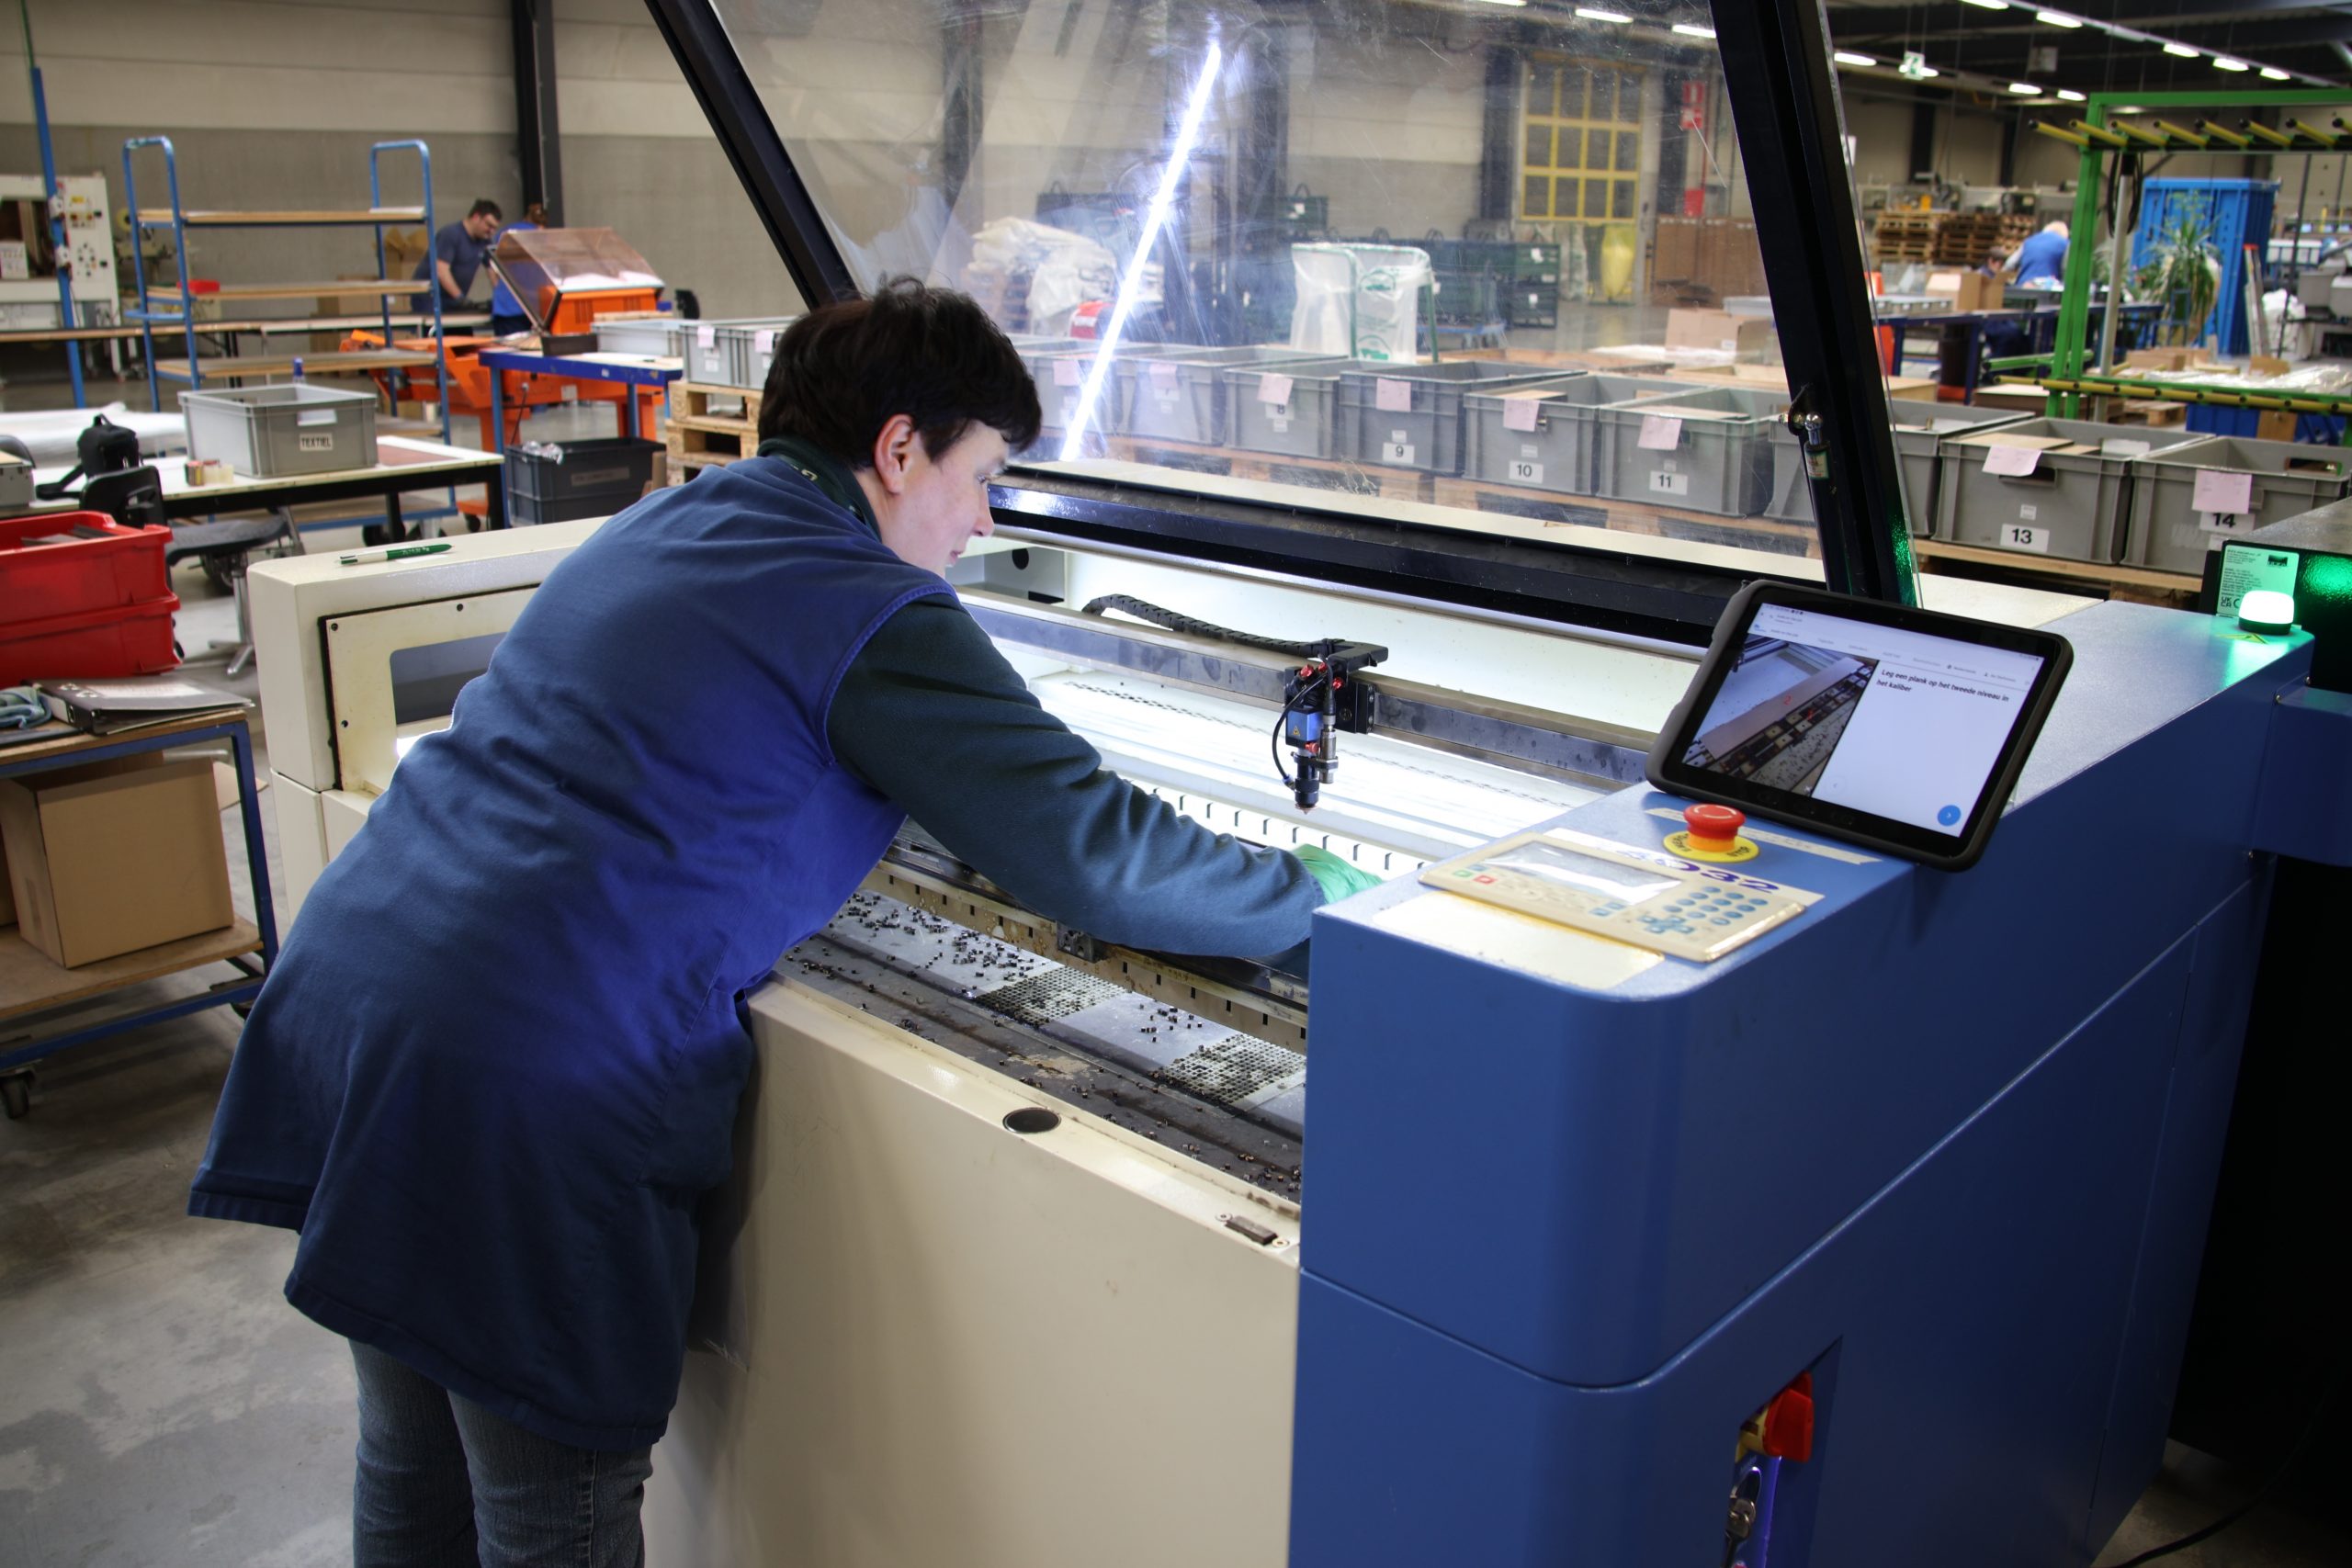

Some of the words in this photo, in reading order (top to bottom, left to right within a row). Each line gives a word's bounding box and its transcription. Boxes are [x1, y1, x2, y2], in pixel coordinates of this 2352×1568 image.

[301, 436, 332, 448] TEXTIEL
[1395, 445, 1405, 458] 9
[1516, 463, 1533, 478] 10
[1658, 473, 1672, 489] 11
[2212, 512, 2236, 527] 14
[2012, 527, 2032, 545] 13
[1876, 679, 1888, 687] het
[1888, 682, 1912, 692] kaliber
[1882, 670, 1894, 678] Leg
[1908, 675, 1927, 684] plank
[1938, 681, 1951, 689] het
[1951, 684, 1976, 695] tweede
[1977, 690, 2001, 700] niveau
[2001, 694, 2009, 702] in
